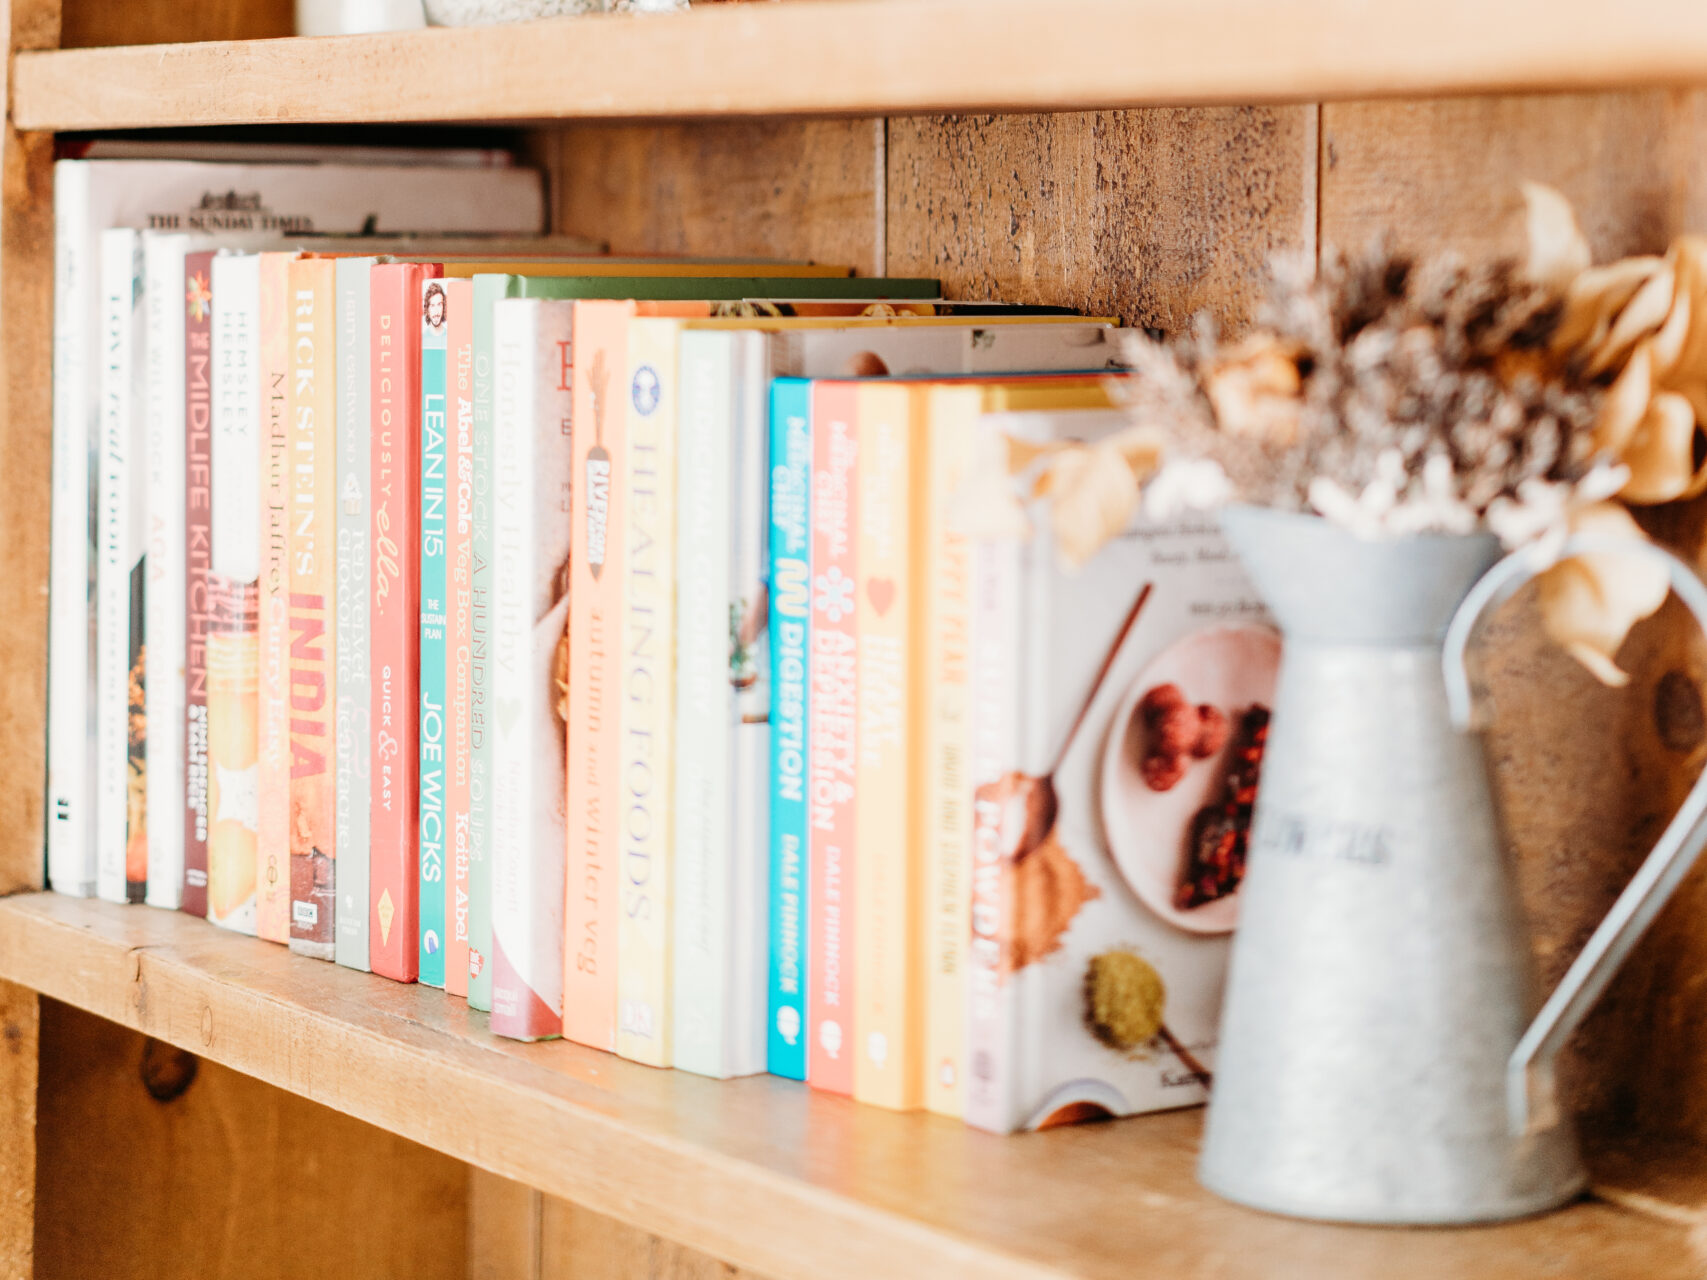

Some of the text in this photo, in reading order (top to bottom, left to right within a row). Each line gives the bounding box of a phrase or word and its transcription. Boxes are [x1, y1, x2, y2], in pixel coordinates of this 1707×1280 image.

[148, 214, 181, 229] THE
[188, 214, 253, 229] SUNDAY
[190, 355, 209, 510] MIDLIFE
[222, 310, 234, 434] HEMSLEY
[237, 310, 249, 434] HEMSLEY
[295, 290, 316, 576] RICK STEIN'S
[380, 314, 392, 497] DELICIOUSLY
[456, 343, 472, 390] The
[267, 371, 286, 597] Madhur Jaffrey
[424, 393, 445, 558] LEAN IN 15
[497, 340, 524, 674] Honestly Healthy
[188, 523, 207, 697] KITCHEN
[454, 537, 471, 585] Veg
[456, 587, 470, 639] Box
[469, 352, 491, 863] ONE STOCK A HUNDRED SOUPS
[266, 597, 287, 770] Curry Easy
[290, 592, 327, 781] INDIA
[378, 665, 399, 812] QUICK & EASY
[452, 645, 470, 787] Companion
[625, 442, 658, 922] HEALING FOODS
[778, 620, 805, 802] DIGESTION
[813, 629, 838, 832] DEPRESSION
[835, 630, 858, 779] ANXIETY
[422, 691, 443, 883] JOE WICKS
[576, 607, 608, 977] autumn and winter veg
[780, 833, 801, 891] DALE
[455, 810, 469, 942] Keith Abel
[824, 845, 842, 903] DALE
